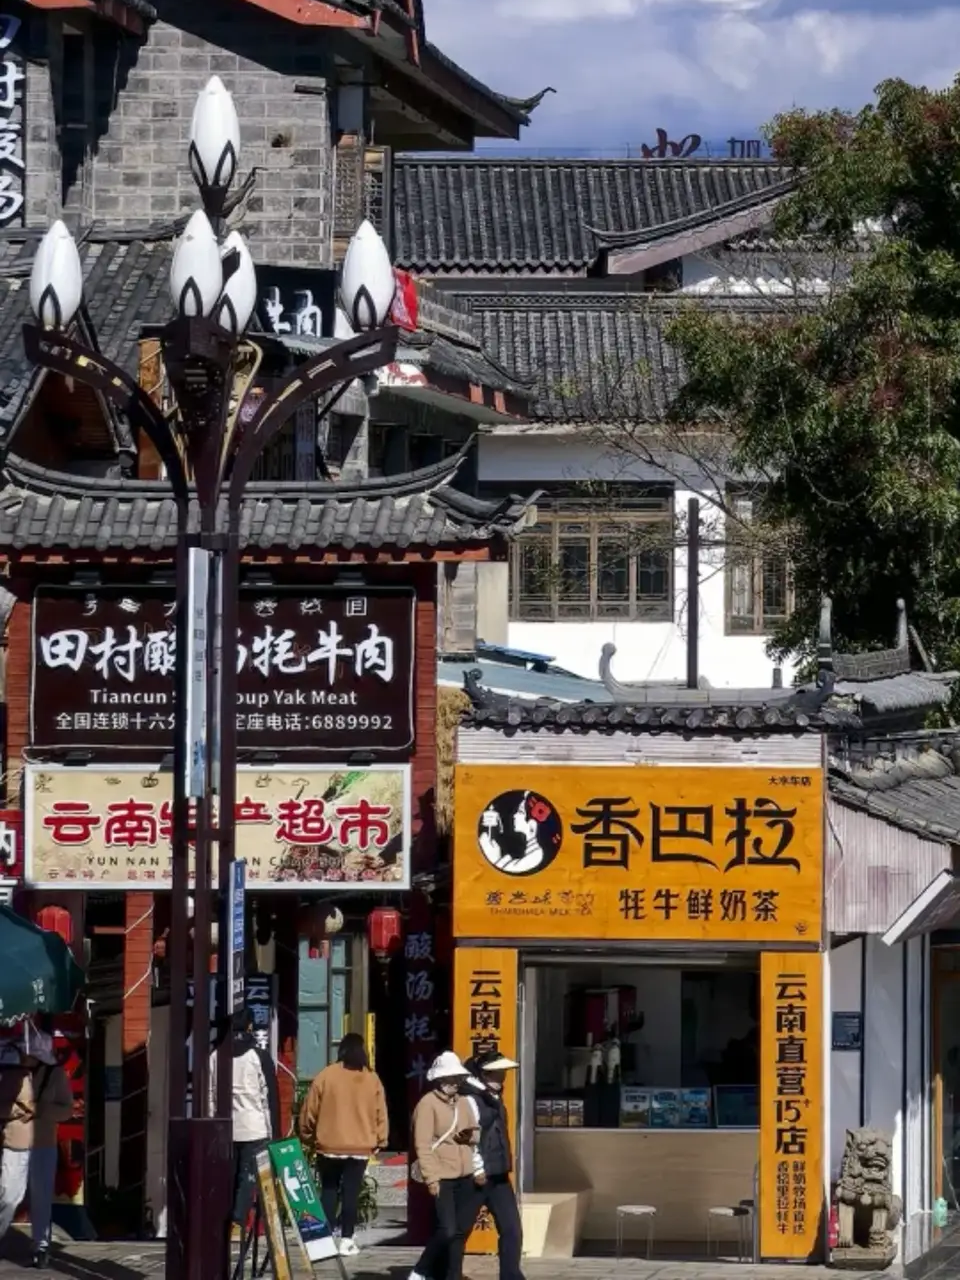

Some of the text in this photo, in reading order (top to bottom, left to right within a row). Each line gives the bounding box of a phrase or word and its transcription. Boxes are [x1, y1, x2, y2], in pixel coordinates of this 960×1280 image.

[40, 620, 393, 686] 田村酸牦牛肉
[90, 689, 167, 704] Tiancun
[236, 693, 269, 708] oup
[273, 689, 306, 705] Yak
[311, 690, 358, 705] Meat
[570, 796, 800, 874] 香巴拉
[87, 856, 118, 866] YUN
[126, 856, 160, 866] NAN
[619, 888, 780, 922] 牦牛鲜奶茶
